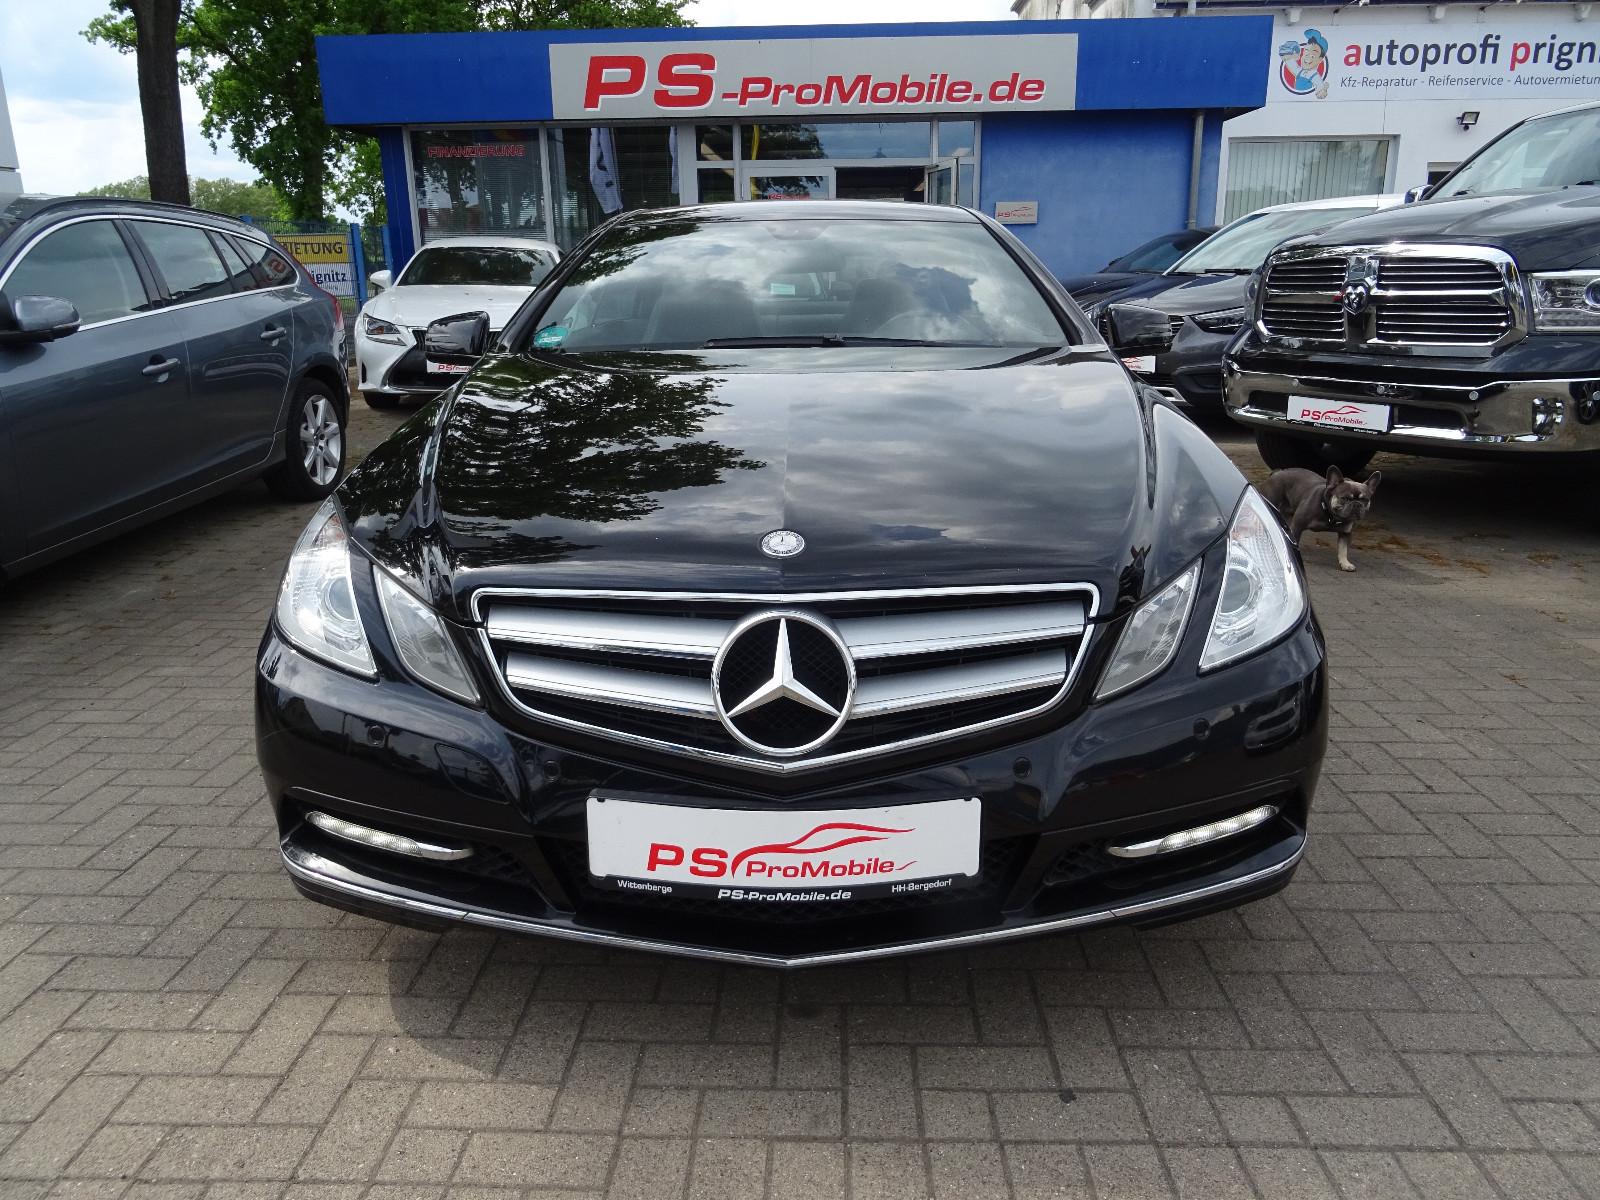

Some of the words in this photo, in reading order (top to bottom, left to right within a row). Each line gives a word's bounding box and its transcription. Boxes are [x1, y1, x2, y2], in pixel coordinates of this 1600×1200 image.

[1344, 34, 1501, 72] autoprofi
[1509, 33, 1600, 71] prign
[584, 53, 1046, 112] PS-ProMobile.de
[1340, 75, 1418, 89] Kfz-Reparatur
[1428, 74, 1504, 87] Reifenservice
[1300, 409, 1322, 421] PS
[1324, 414, 1364, 425] ProMobile
[647, 842, 729, 878] PS
[745, 857, 896, 878] ProMobile
[617, 879, 673, 894] Wittenberge
[891, 878, 953, 893] HH-Bergedorf
[717, 888, 852, 902] PS-ProMobile.de
